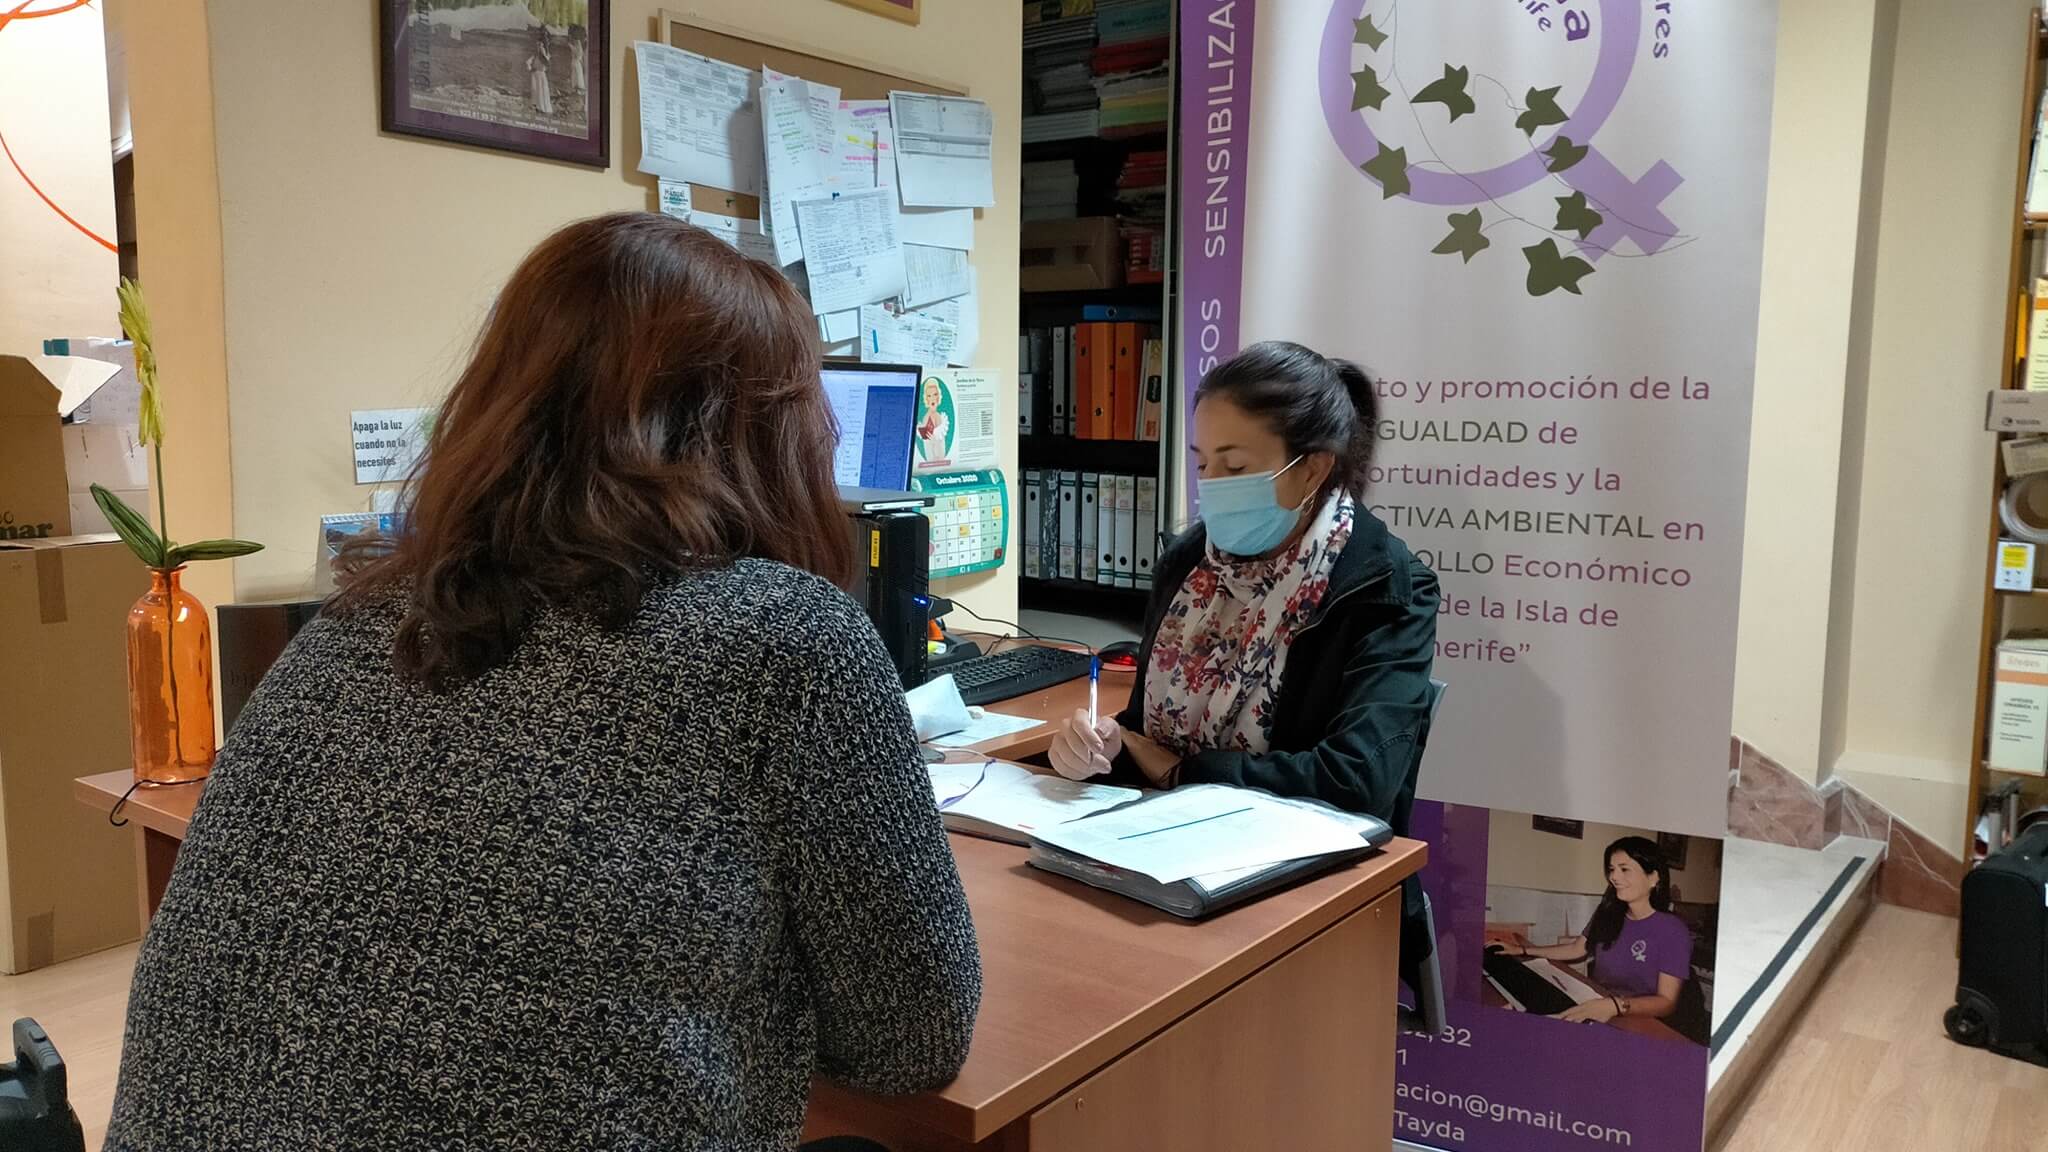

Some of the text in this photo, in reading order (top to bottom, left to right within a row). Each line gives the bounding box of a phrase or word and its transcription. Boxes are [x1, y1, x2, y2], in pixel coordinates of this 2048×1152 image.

[1518, 0, 1552, 32] ife
[1556, 0, 1590, 41] a
[1653, 0, 1671, 59] res
[1204, 0, 1236, 258] SENSIBILIZA
[1375, 375, 1710, 404] to y promoción de la
[353, 419, 403, 434] Apaga la luz
[1376, 419, 1578, 445] GUALDAD de
[355, 437, 407, 450] cuando no la
[357, 456, 397, 468] necesites
[1565, 472, 1585, 495] y
[1595, 467, 1621, 491] la
[1461, 508, 1655, 539] AMBIENTAL
[1663, 521, 1704, 541] en
[1504, 554, 1691, 587] Económico
[1438, 593, 1619, 627] de la Isla de
[1394, 1109, 1465, 1142] Tayda
[1396, 1082, 1632, 1147] acion@gmail.com
